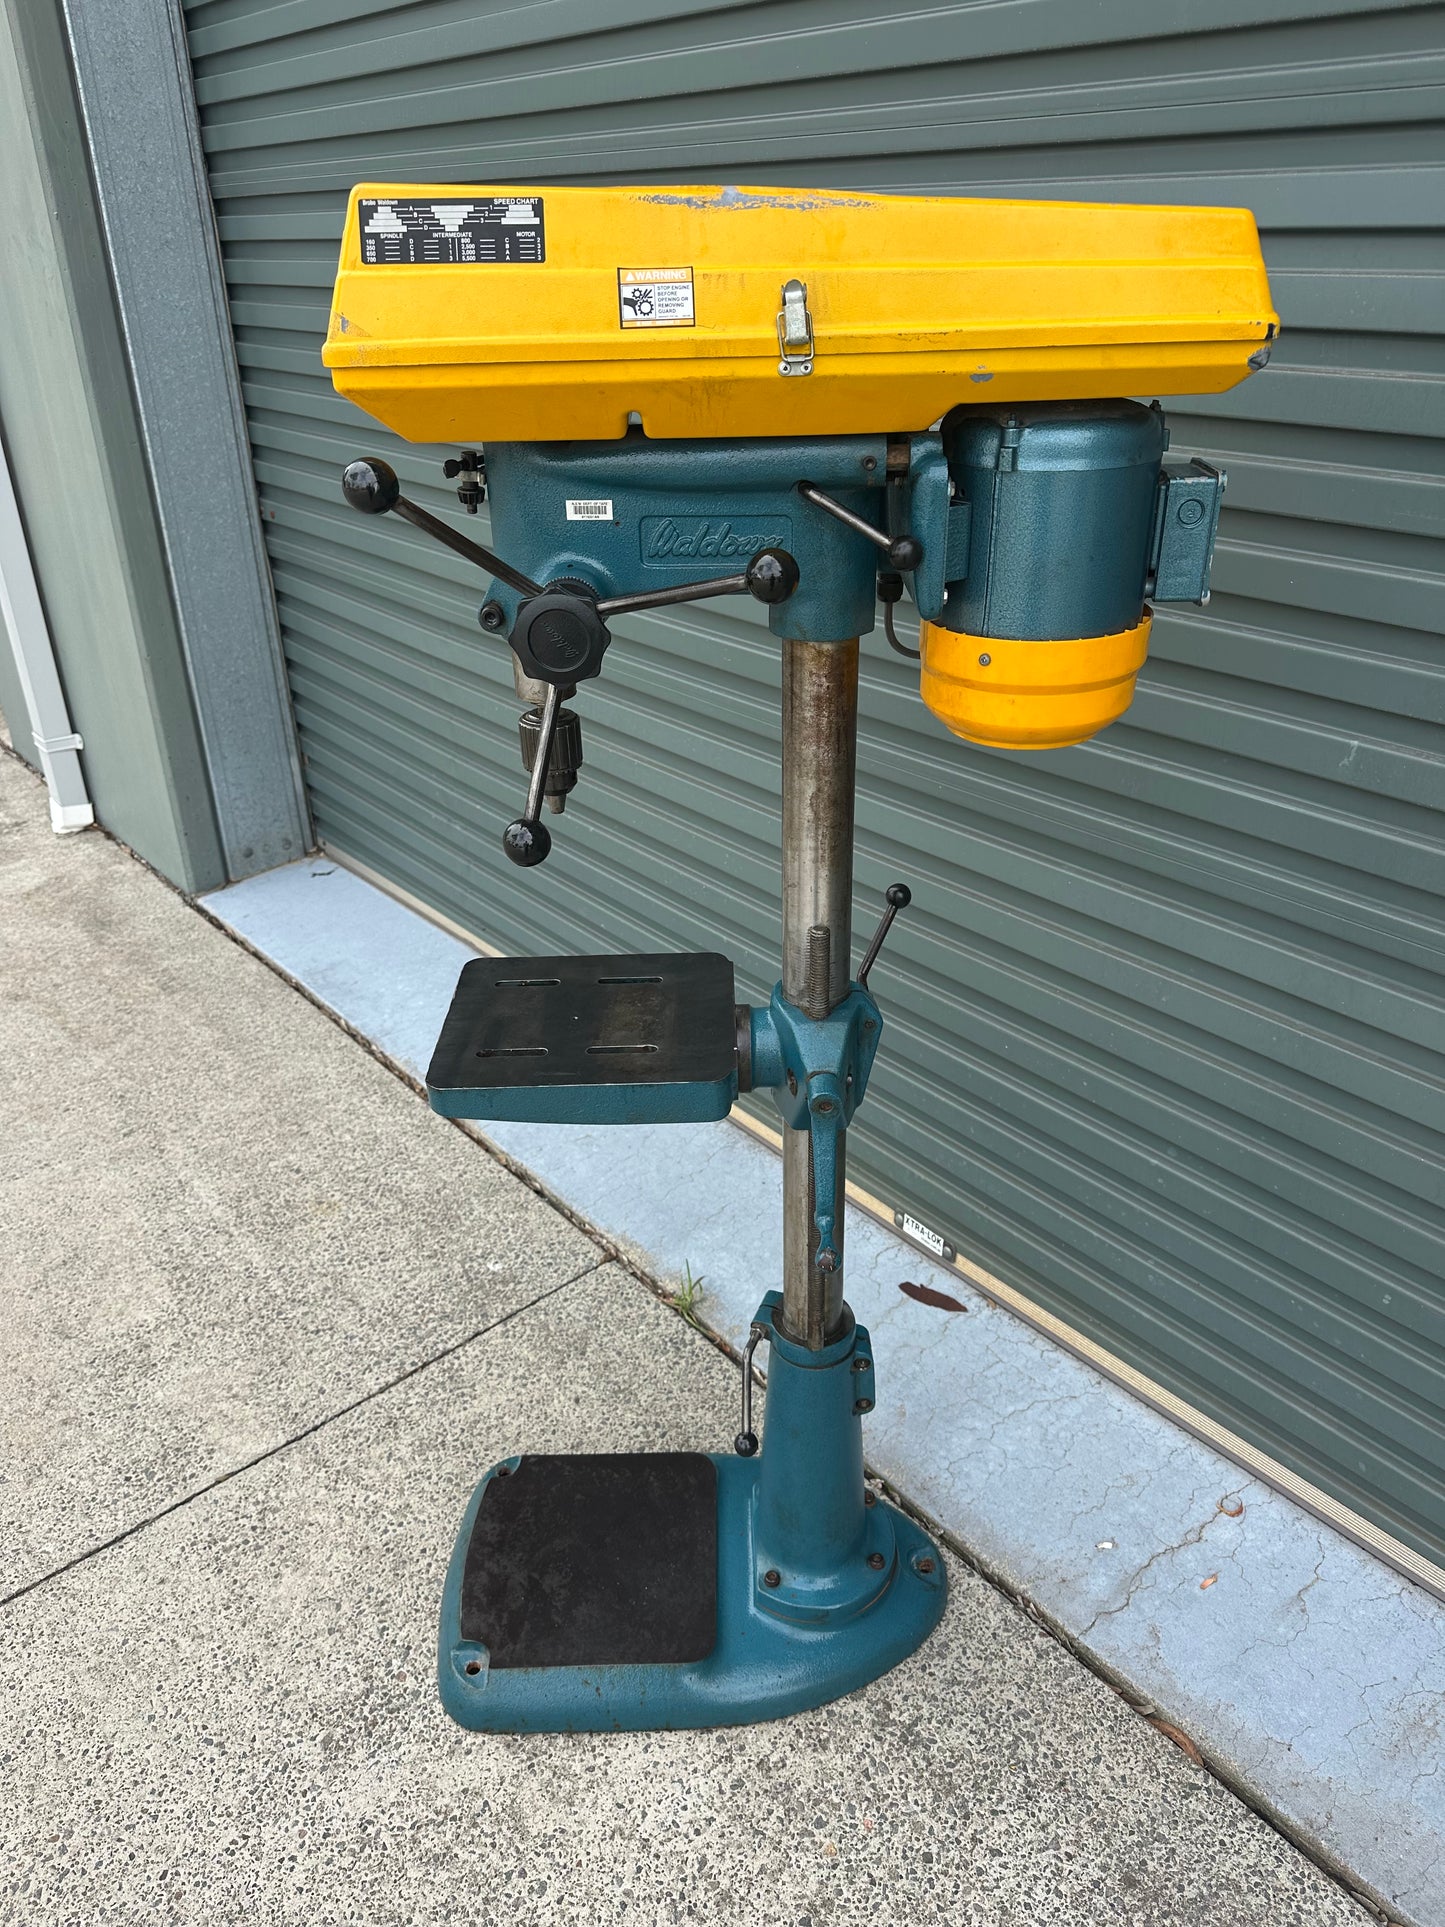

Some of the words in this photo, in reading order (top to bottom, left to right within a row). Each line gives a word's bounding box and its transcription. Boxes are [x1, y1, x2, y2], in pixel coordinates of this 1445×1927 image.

[636, 270, 686, 280] WARNING
[648, 517, 784, 558] Waldown
[905, 1216, 942, 1248] XTRA-LOK
